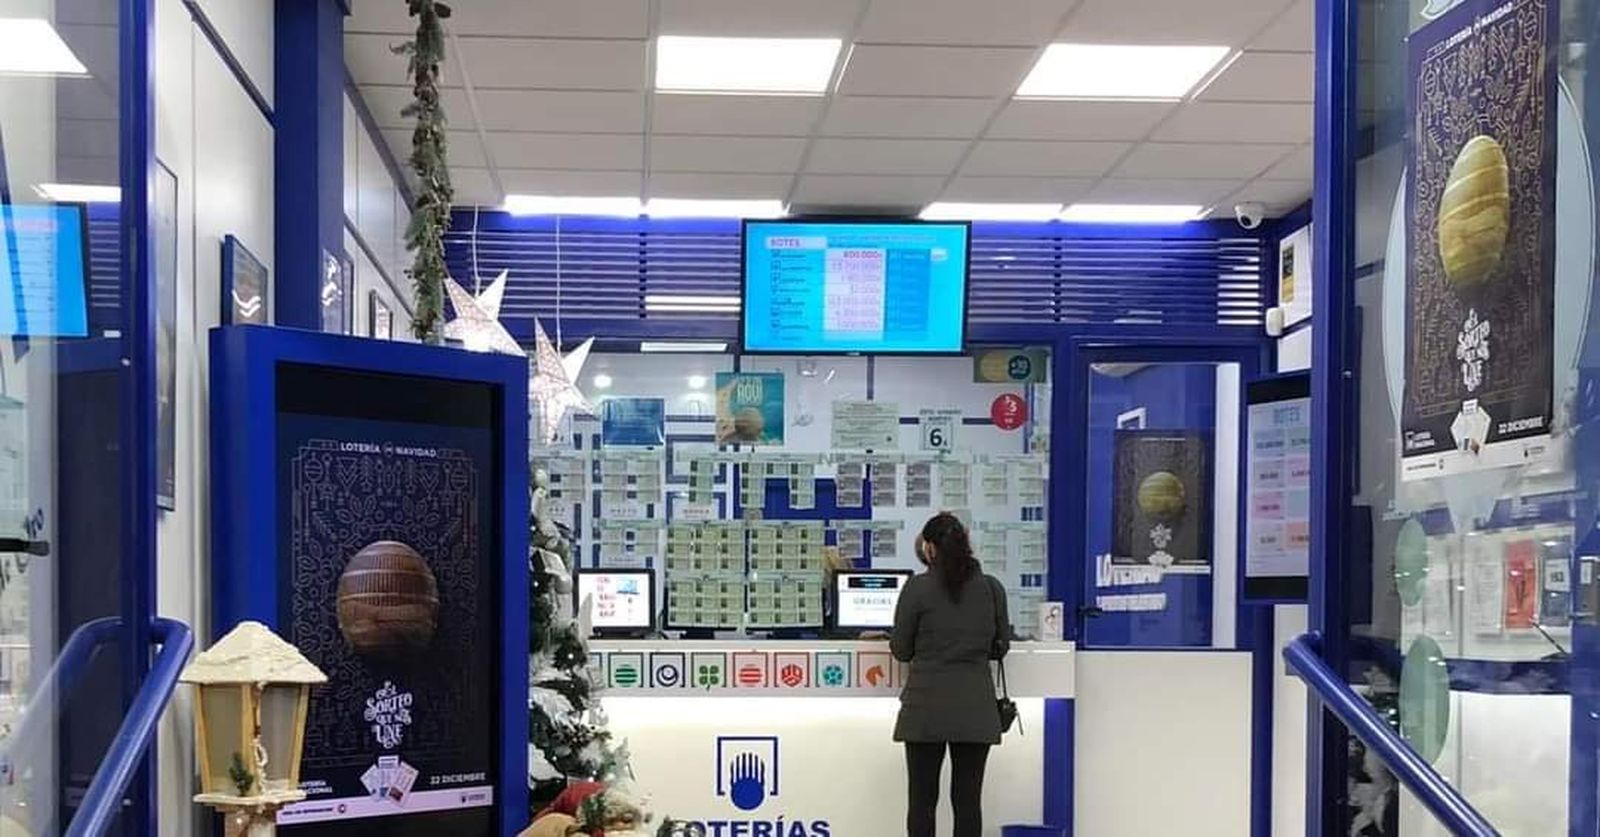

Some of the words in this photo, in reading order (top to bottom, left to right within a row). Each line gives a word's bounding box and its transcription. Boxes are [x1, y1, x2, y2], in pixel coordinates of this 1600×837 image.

[340, 442, 381, 454] LOTERÍA
[395, 446, 437, 458] NAVIDAD
[364, 692, 413, 720] SORTEO
[371, 724, 404, 749] UNE
[442, 772, 486, 783] DICIEMBRE
[685, 815, 831, 837] OTERÍAS
